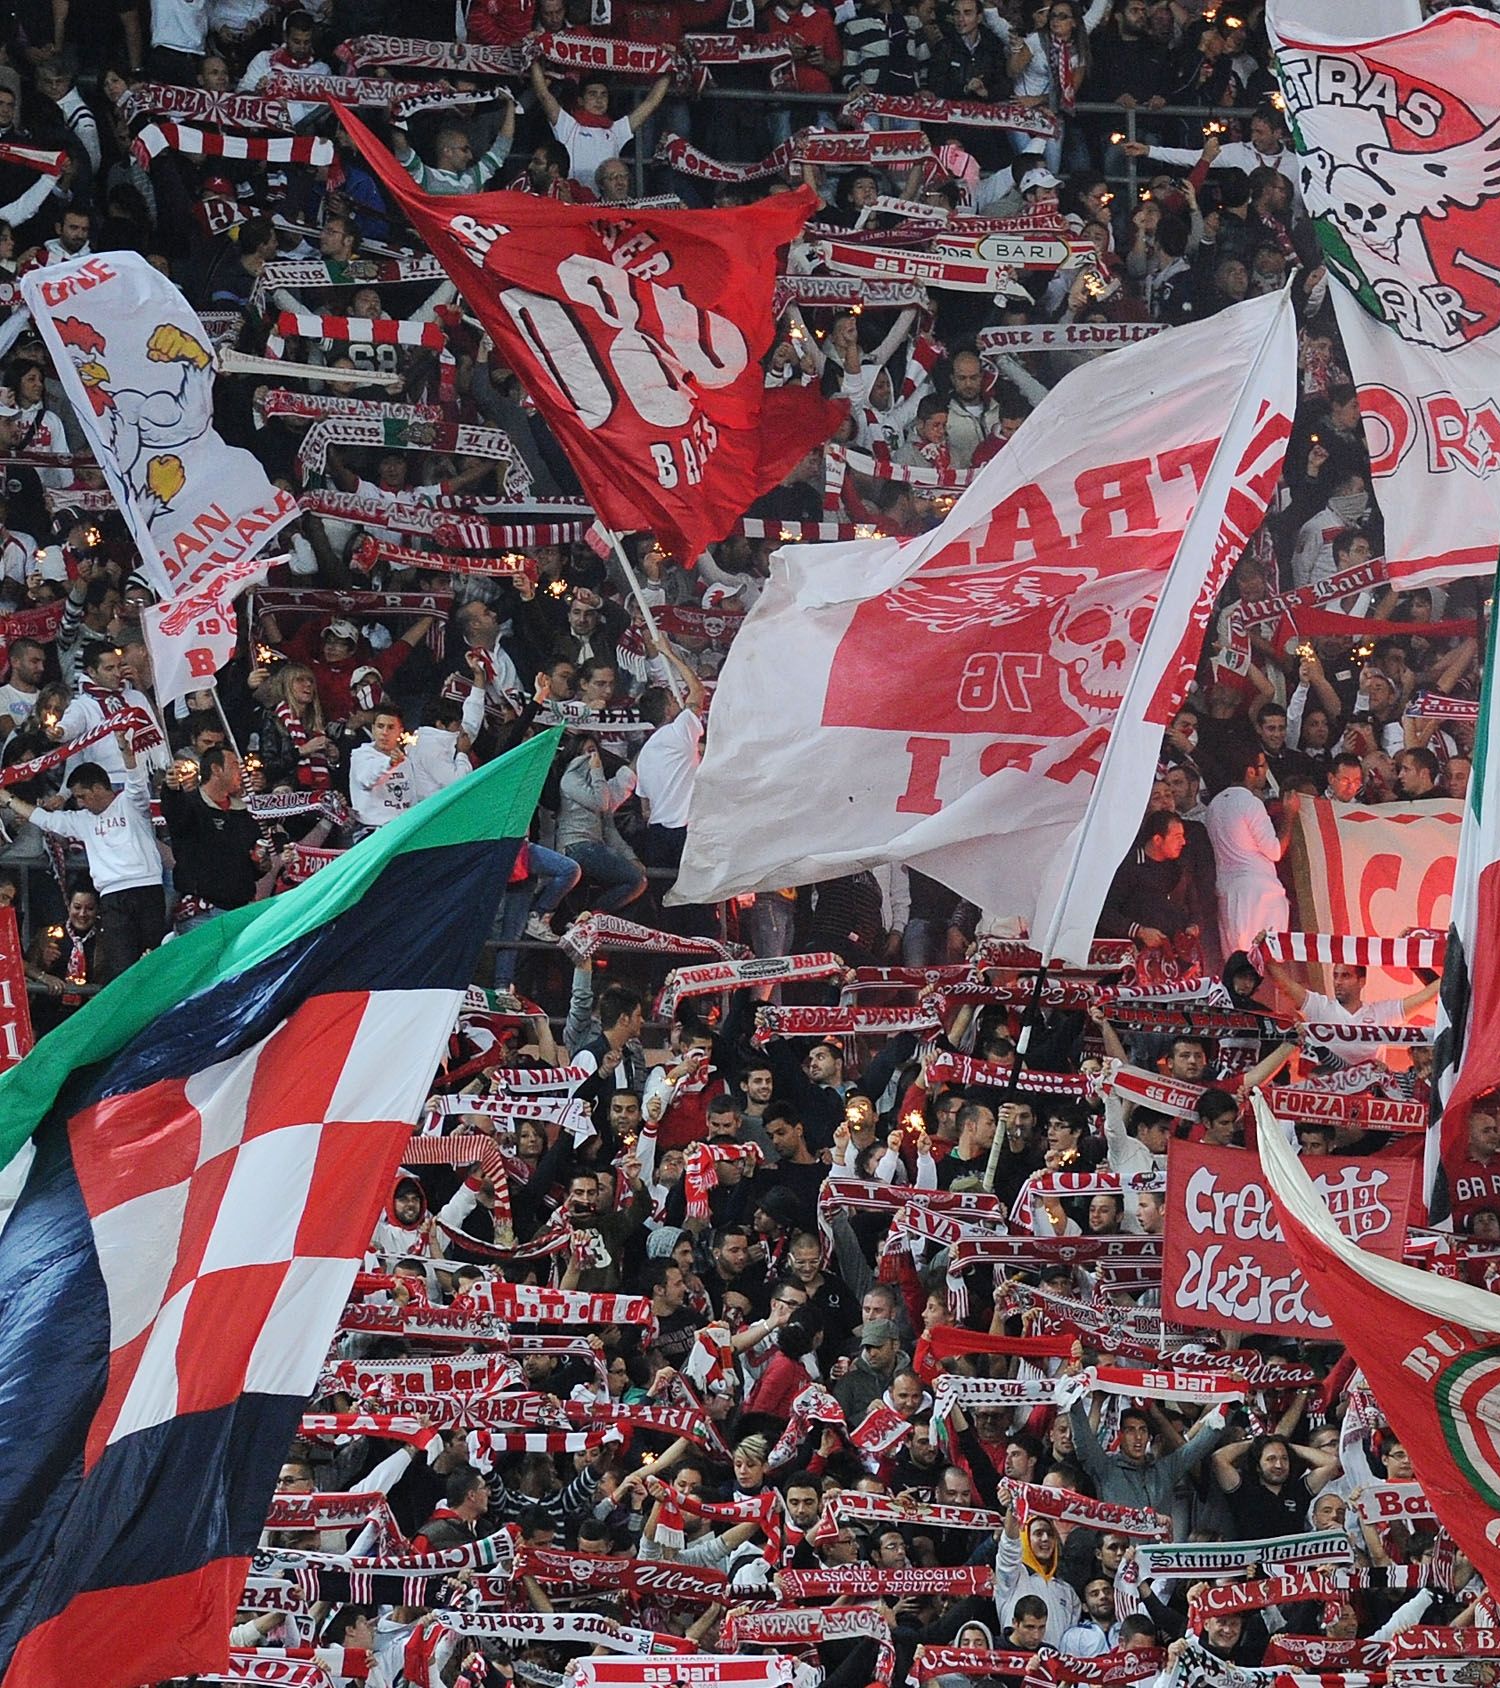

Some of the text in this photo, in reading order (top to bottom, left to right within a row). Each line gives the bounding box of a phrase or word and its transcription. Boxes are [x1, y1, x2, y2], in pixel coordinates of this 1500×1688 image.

[996, 244, 1054, 260] BARI
[873, 256, 946, 280] as bari
[680, 951, 834, 985] FORZA BARI
[1307, 1023, 1429, 1044] CURVA
[1145, 1084, 1198, 1110] as bari
[1273, 1089, 1344, 1117] FORZA
[1367, 1101, 1425, 1127] BARI
[1141, 1371, 1218, 1392] as bari
[611, 1402, 694, 1432] BARI
[1374, 1492, 1435, 1513] Bar
[1149, 1537, 1349, 1570] Stampo Italiano
[633, 1565, 727, 1596] Ultra
[801, 1568, 873, 1583] PASSIONE
[895, 1568, 968, 1582] ORGOGLIO
[850, 1581, 880, 1593] TUO
[642, 1662, 721, 1683] as bari
